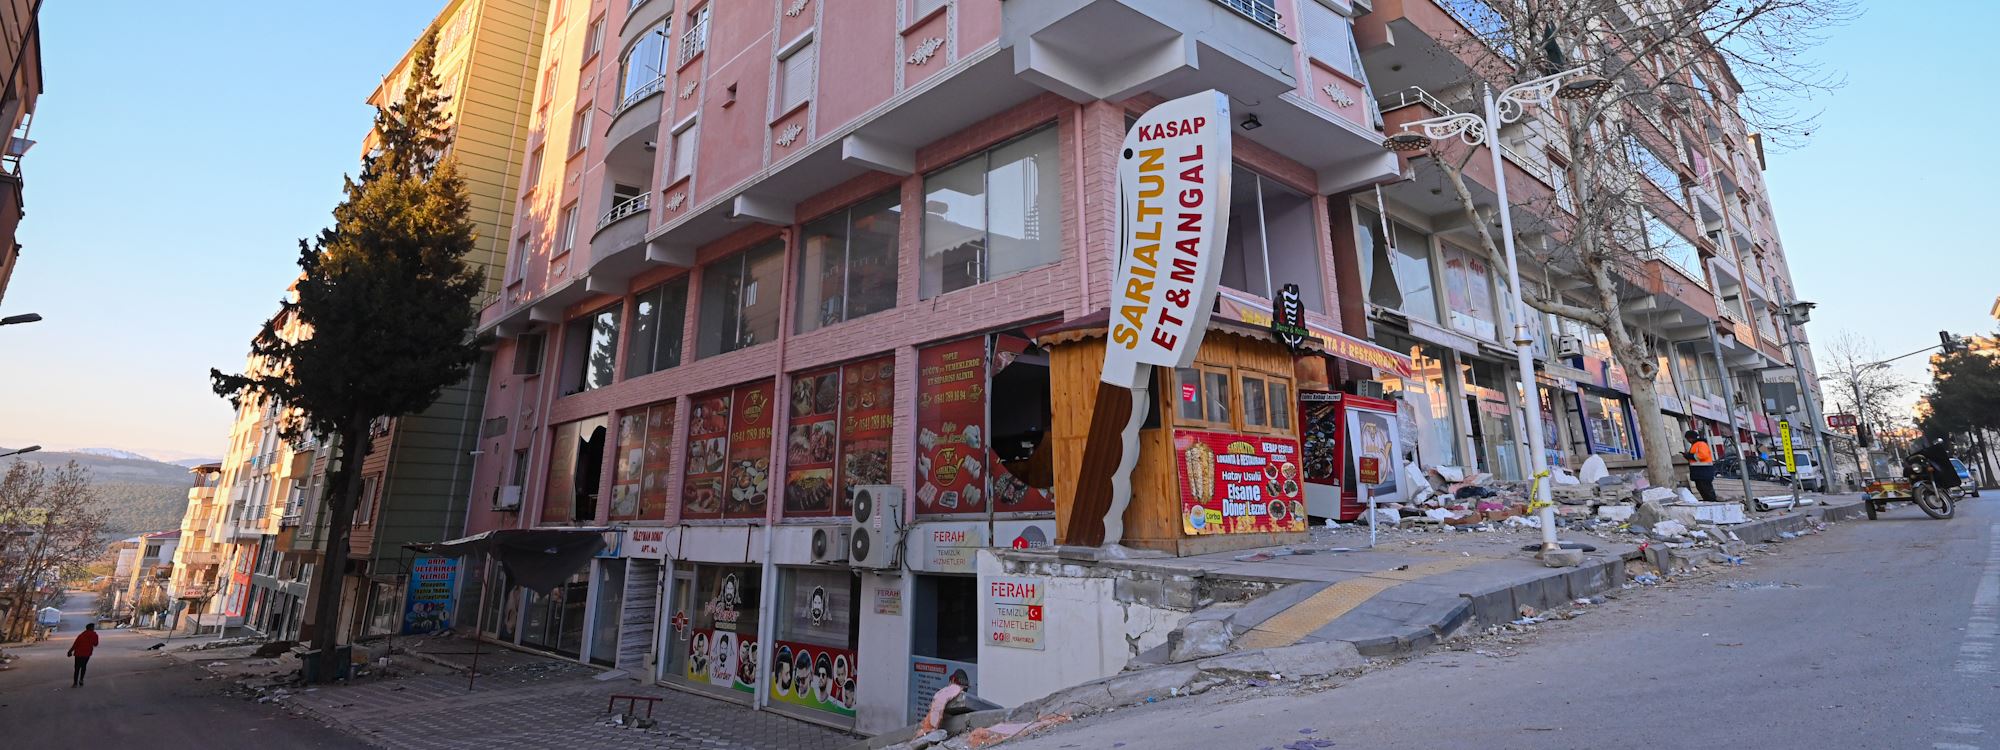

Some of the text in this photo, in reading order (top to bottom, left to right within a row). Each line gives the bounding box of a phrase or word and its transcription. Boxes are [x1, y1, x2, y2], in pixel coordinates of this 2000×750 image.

[1138, 116, 1206, 143] KASAP
[1112, 147, 1165, 350] SARIALTUN
[1222, 471, 1242, 483] Hatay
[1228, 483, 1261, 501] Efsane
[1222, 498, 1246, 517] Döner
[934, 531, 965, 543] FERAH
[991, 582, 1034, 598] FERAH
[991, 619, 1037, 630] HİZMETLERİ
